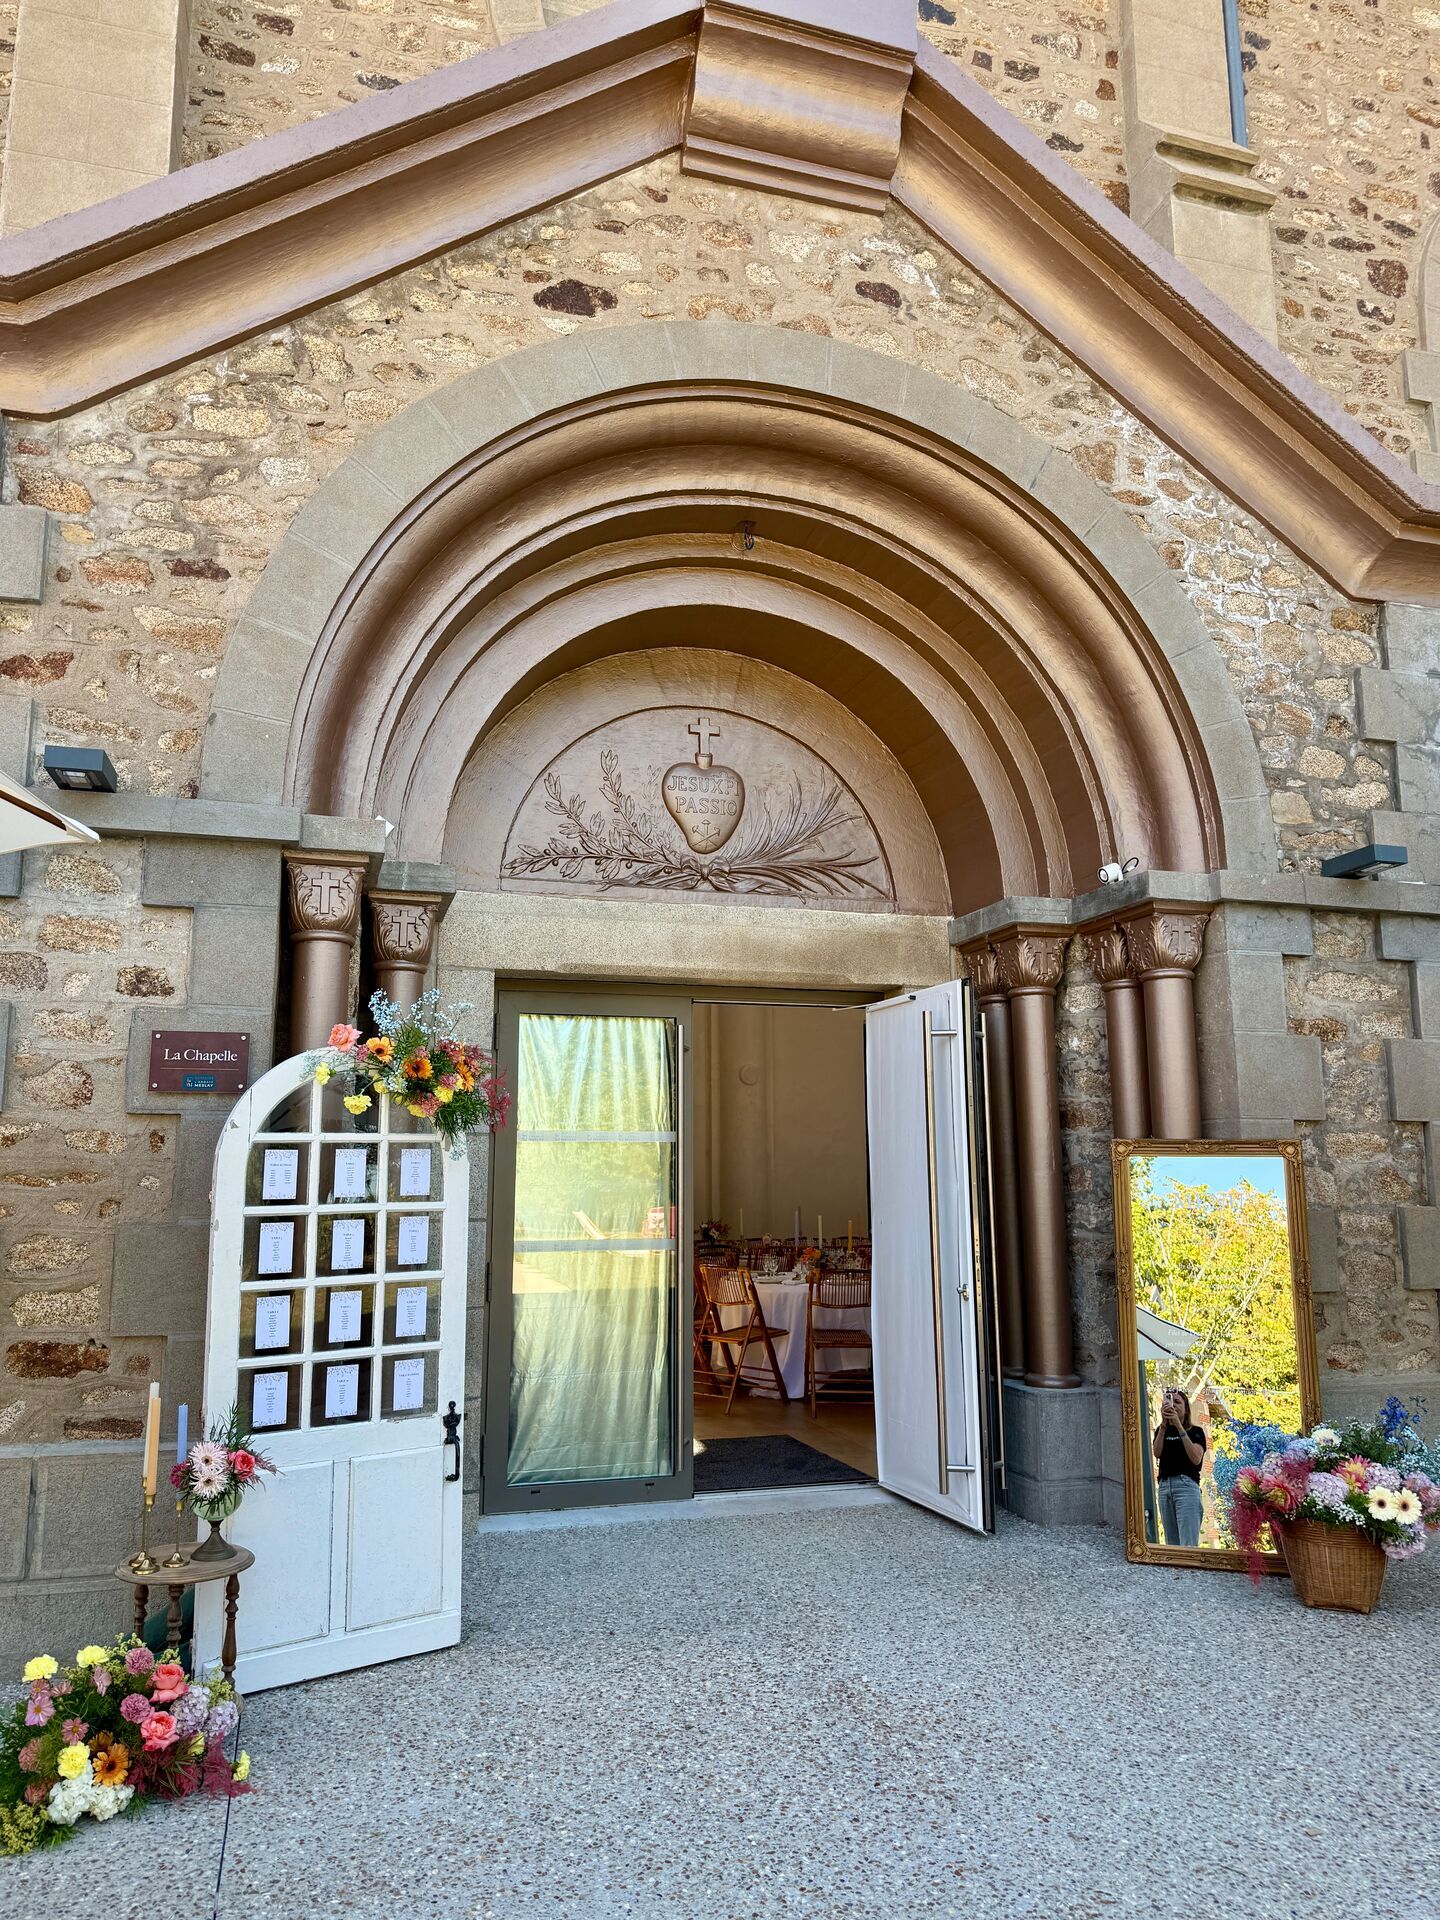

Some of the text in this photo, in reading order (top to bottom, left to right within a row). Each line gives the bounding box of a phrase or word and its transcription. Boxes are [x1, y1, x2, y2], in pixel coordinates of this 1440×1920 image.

[675, 796, 738, 817] PASSIO
[163, 1048, 238, 1064] La Chapelle
